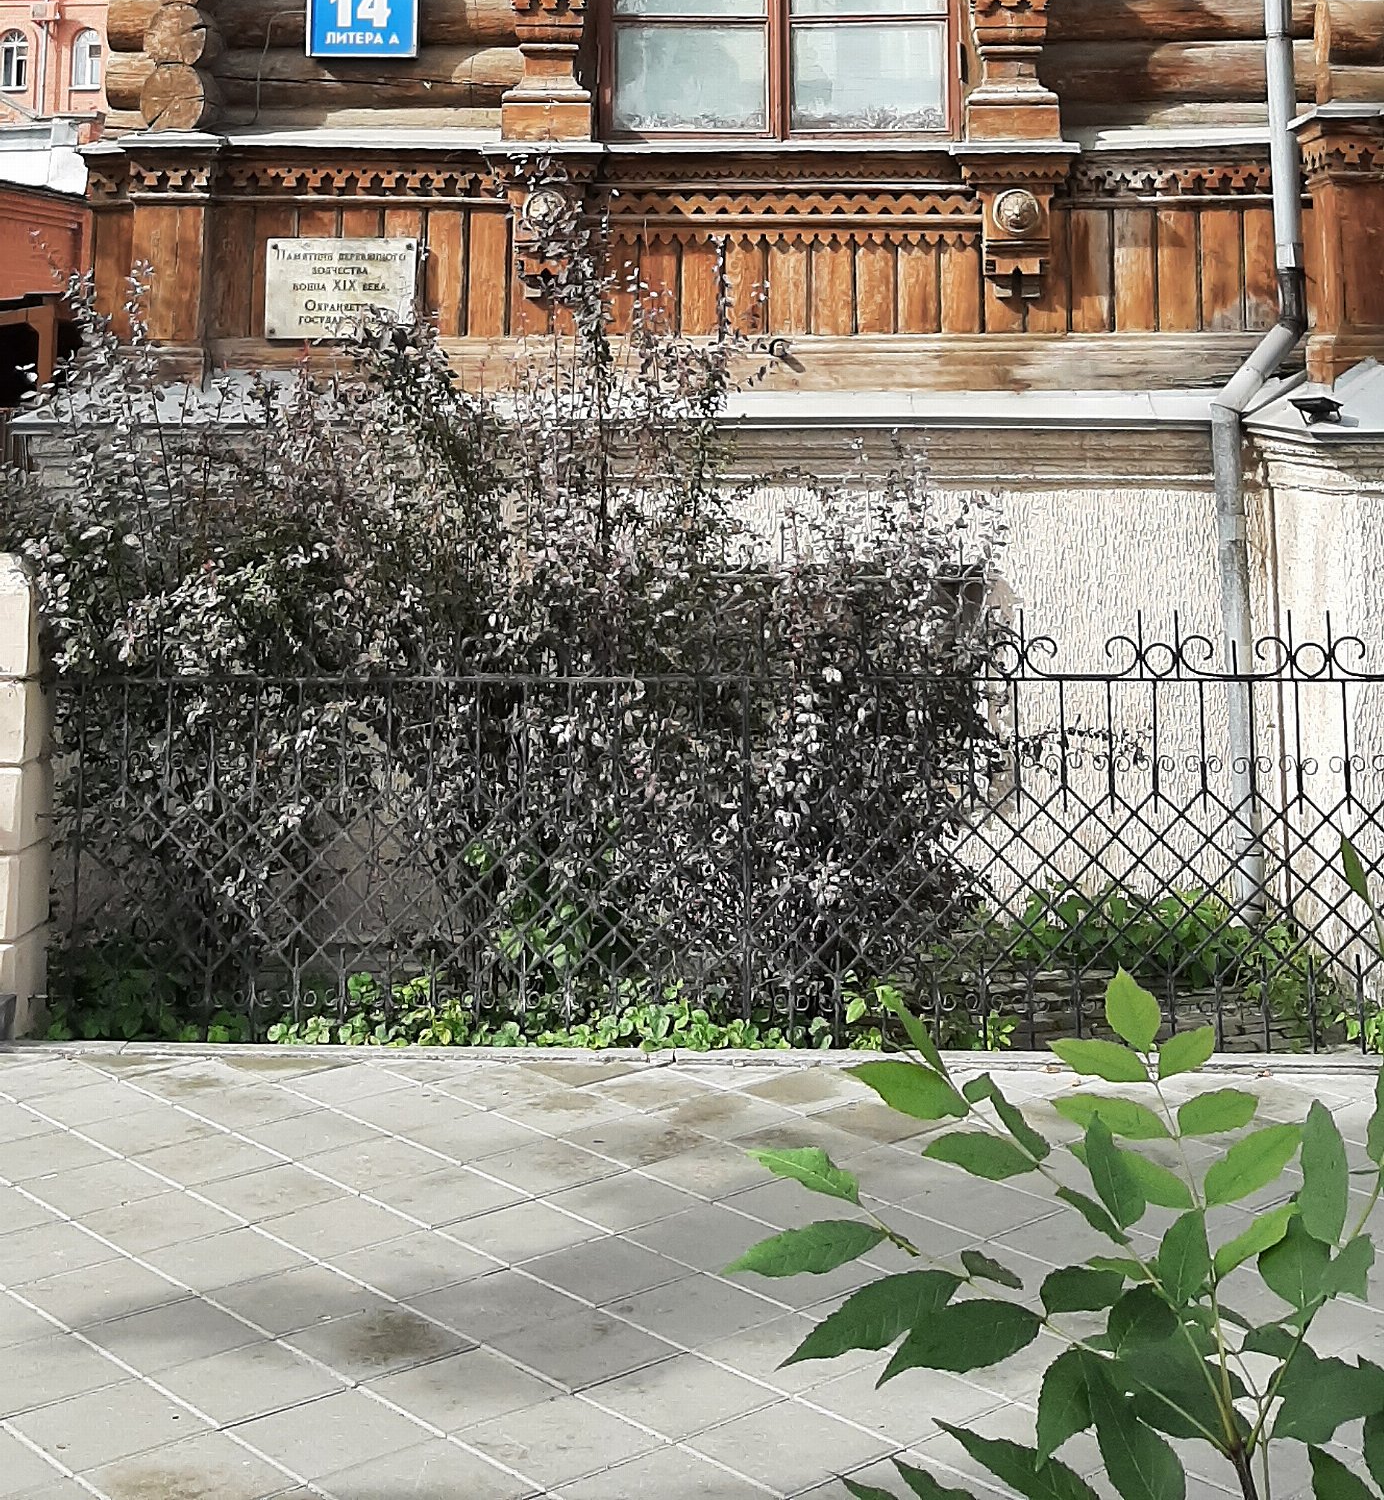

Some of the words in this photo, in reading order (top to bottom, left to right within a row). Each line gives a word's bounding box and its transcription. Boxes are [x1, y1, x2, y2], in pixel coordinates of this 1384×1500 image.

[325, 31, 384, 44] ЛИТЕРА
[388, 33, 400, 44] А
[332, 279, 357, 292] XIX
[304, 299, 372, 312] ОХРАНЯЕТ
